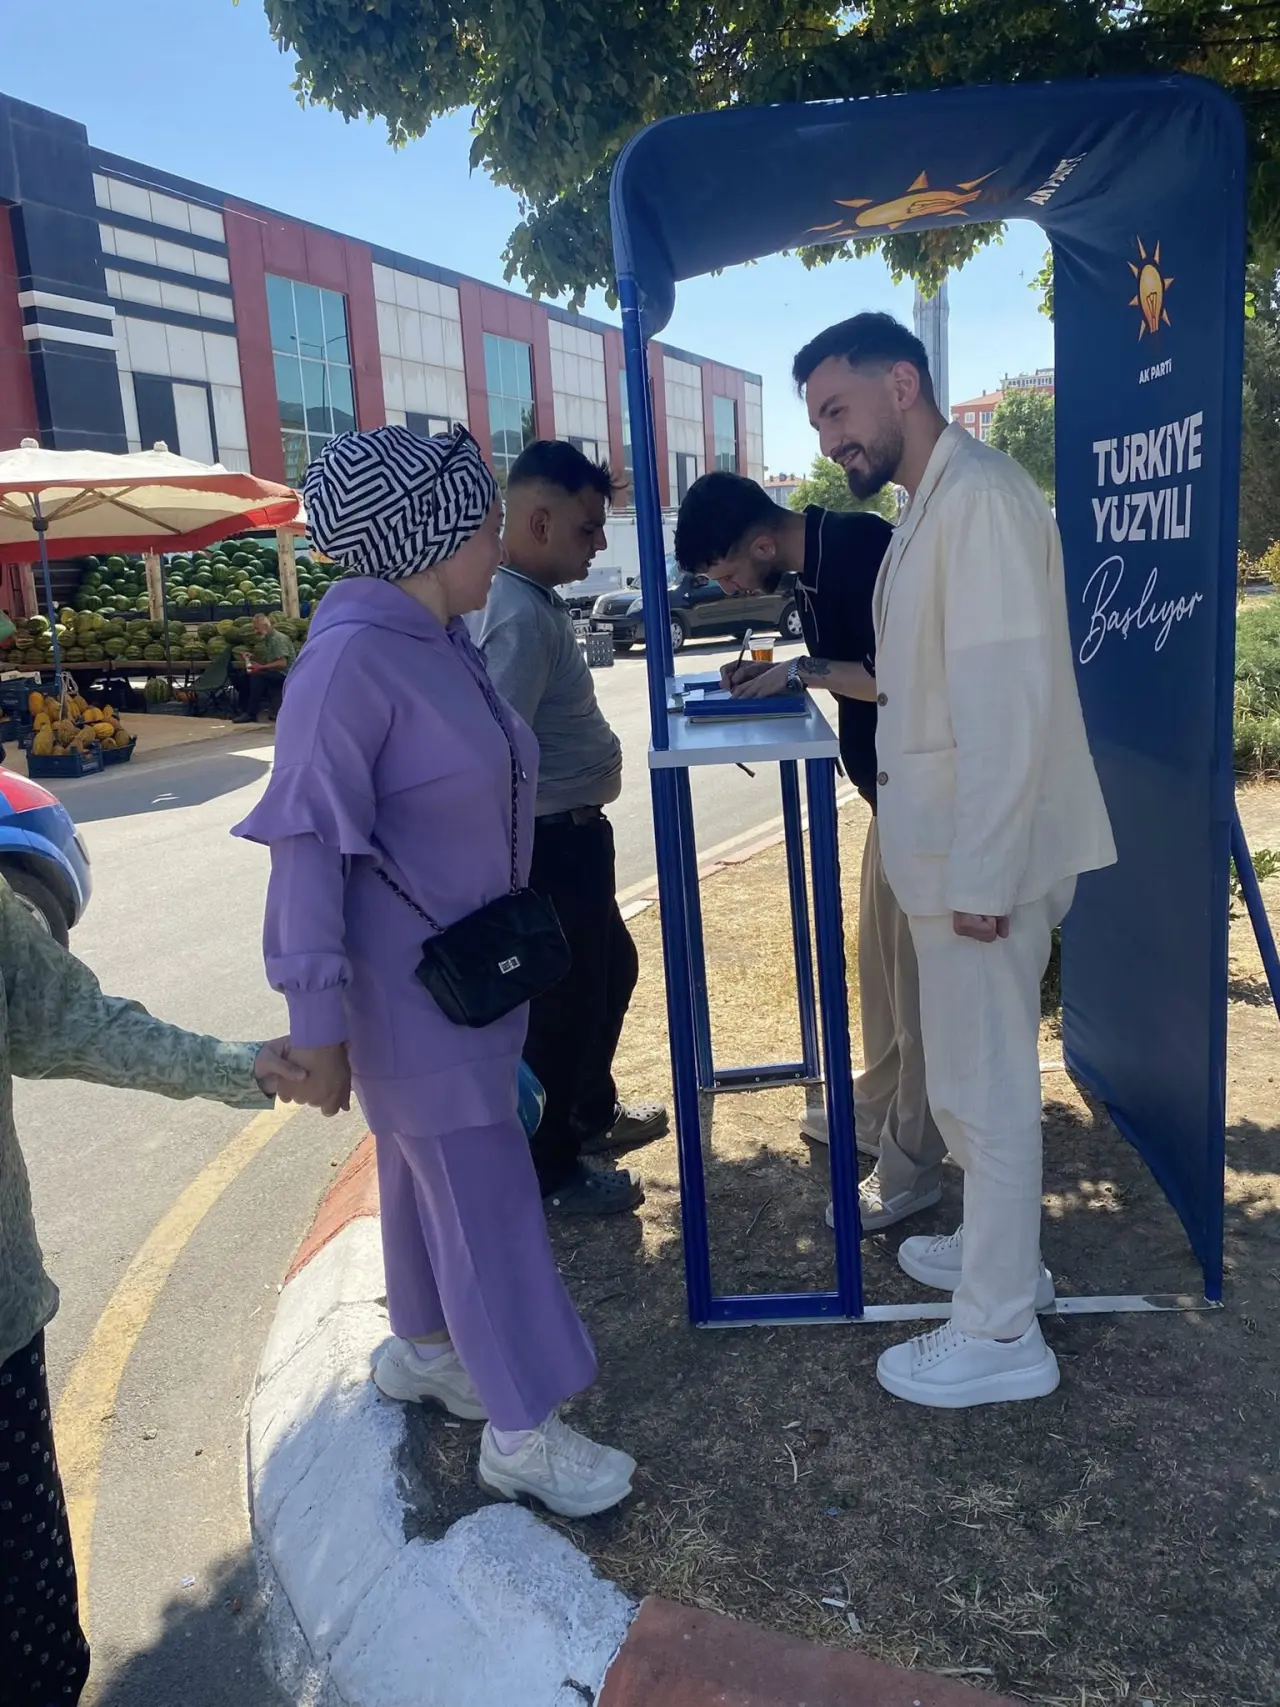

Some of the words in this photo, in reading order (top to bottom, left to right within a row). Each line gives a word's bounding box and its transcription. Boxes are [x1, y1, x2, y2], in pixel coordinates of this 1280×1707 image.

[1138, 368, 1150, 385] AK
[1150, 358, 1172, 380] PARTİ
[1092, 410, 1203, 487] TÜRKİYE
[1091, 483, 1192, 543] YÜZYILI
[1079, 555, 1203, 664] Başlıyor
